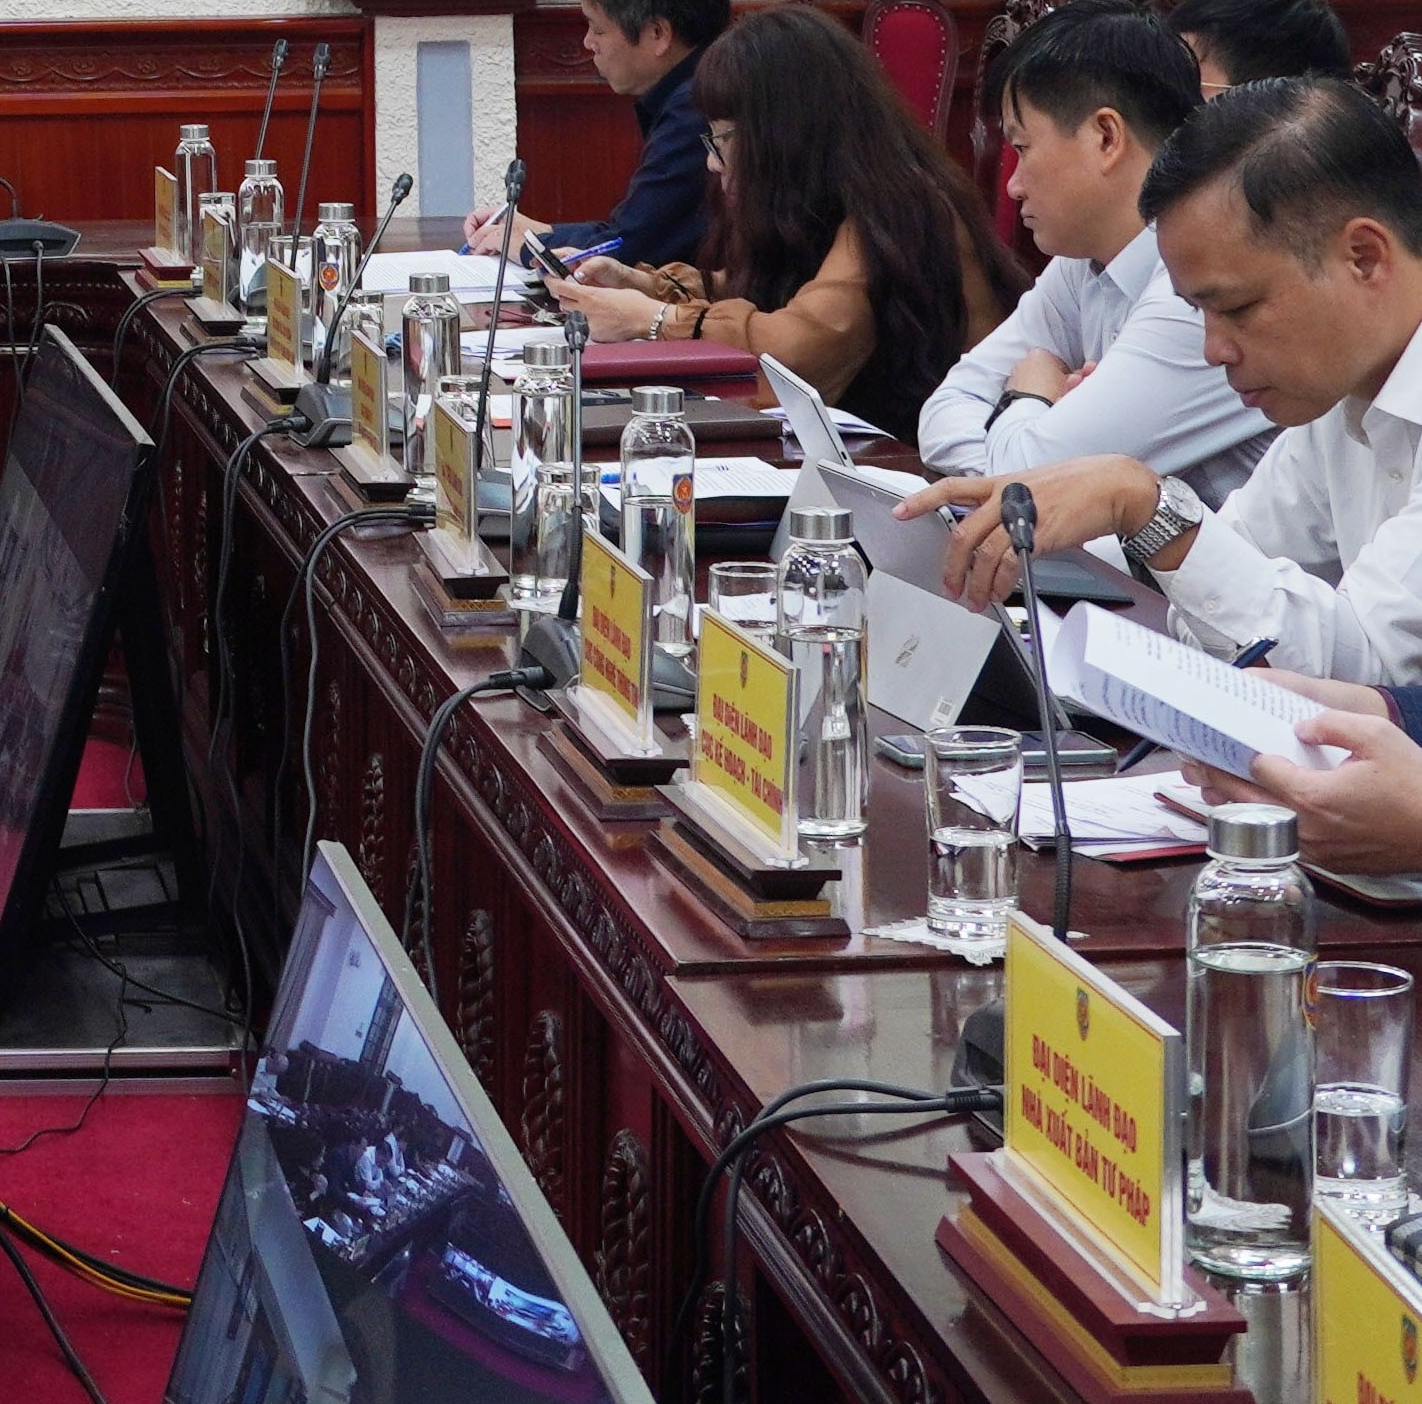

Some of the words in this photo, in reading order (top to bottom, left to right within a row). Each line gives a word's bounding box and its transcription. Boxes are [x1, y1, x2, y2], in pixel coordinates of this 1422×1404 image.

[740, 711, 758, 750] LÃNH
[1032, 1033, 1051, 1083] ĐẠI
[1052, 1051, 1079, 1104] DIỆN
[1081, 1074, 1111, 1133] LÃNH
[1113, 1101, 1137, 1155] ĐẠO
[1021, 1083, 1043, 1134] NHÀ
[1045, 1102, 1073, 1160] XUẤT
[1075, 1127, 1099, 1185] BẢN
[1102, 1154, 1118, 1199] TƯ
[1118, 1170, 1151, 1228] PHÁP
